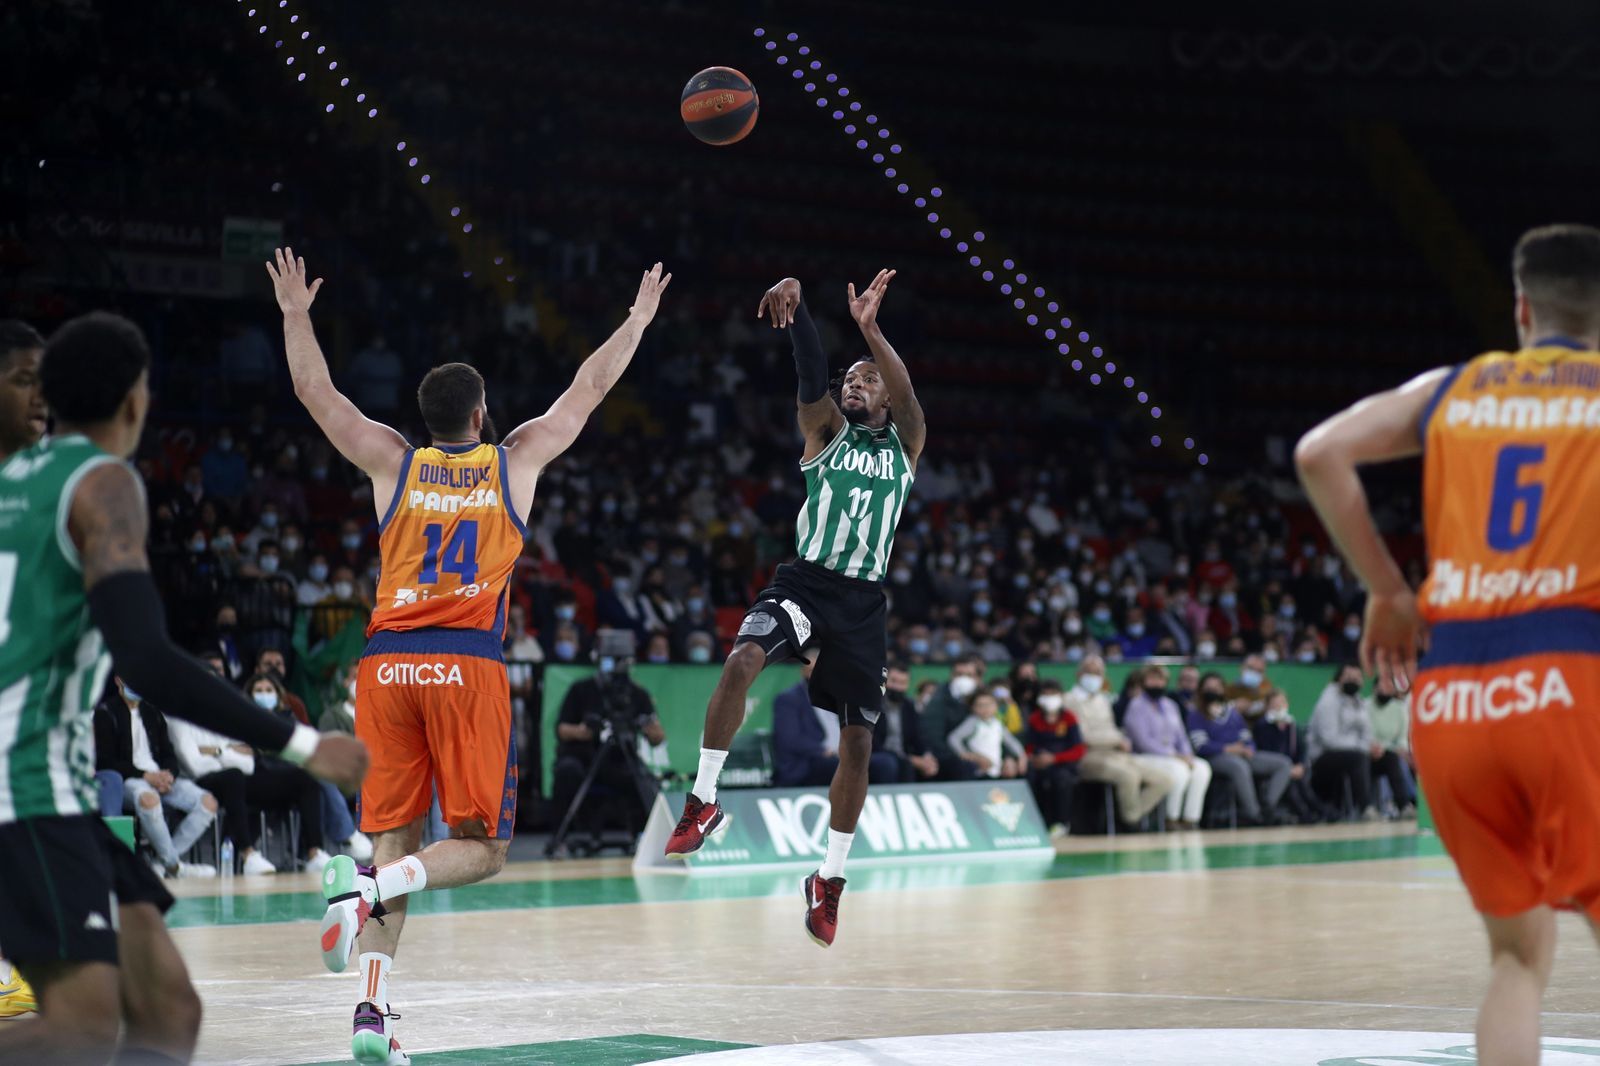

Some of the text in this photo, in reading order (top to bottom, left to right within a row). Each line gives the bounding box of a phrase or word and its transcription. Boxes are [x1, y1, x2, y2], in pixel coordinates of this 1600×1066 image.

[409, 488, 498, 513] PAMESA
[848, 486, 873, 519] 11
[1486, 442, 1546, 554] 6
[417, 519, 479, 585] 14
[377, 662, 464, 686] GITICSA
[857, 792, 971, 852] WAR
